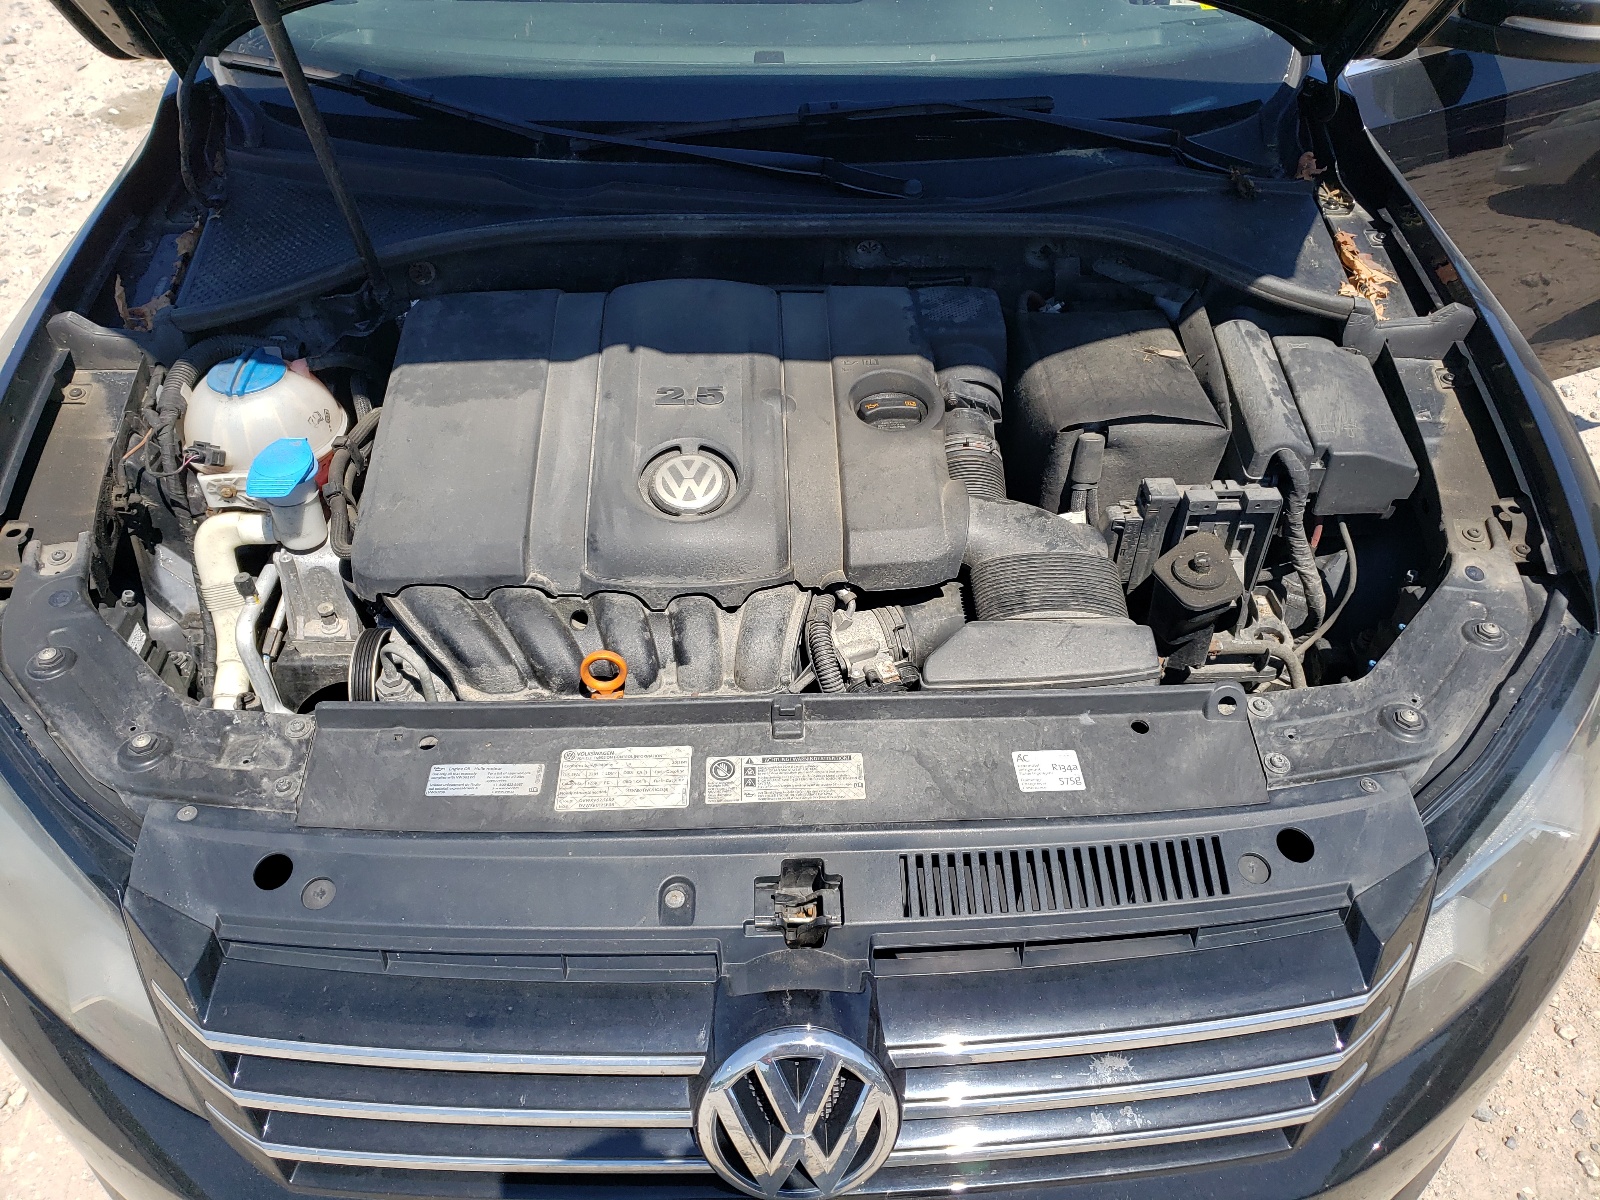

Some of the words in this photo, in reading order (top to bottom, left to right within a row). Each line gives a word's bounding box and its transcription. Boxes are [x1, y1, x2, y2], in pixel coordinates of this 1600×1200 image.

[655, 386, 725, 406] 2.5
[656, 455, 722, 508] VW
[1051, 763, 1079, 773] R134a
[696, 1027, 897, 1199] VW
